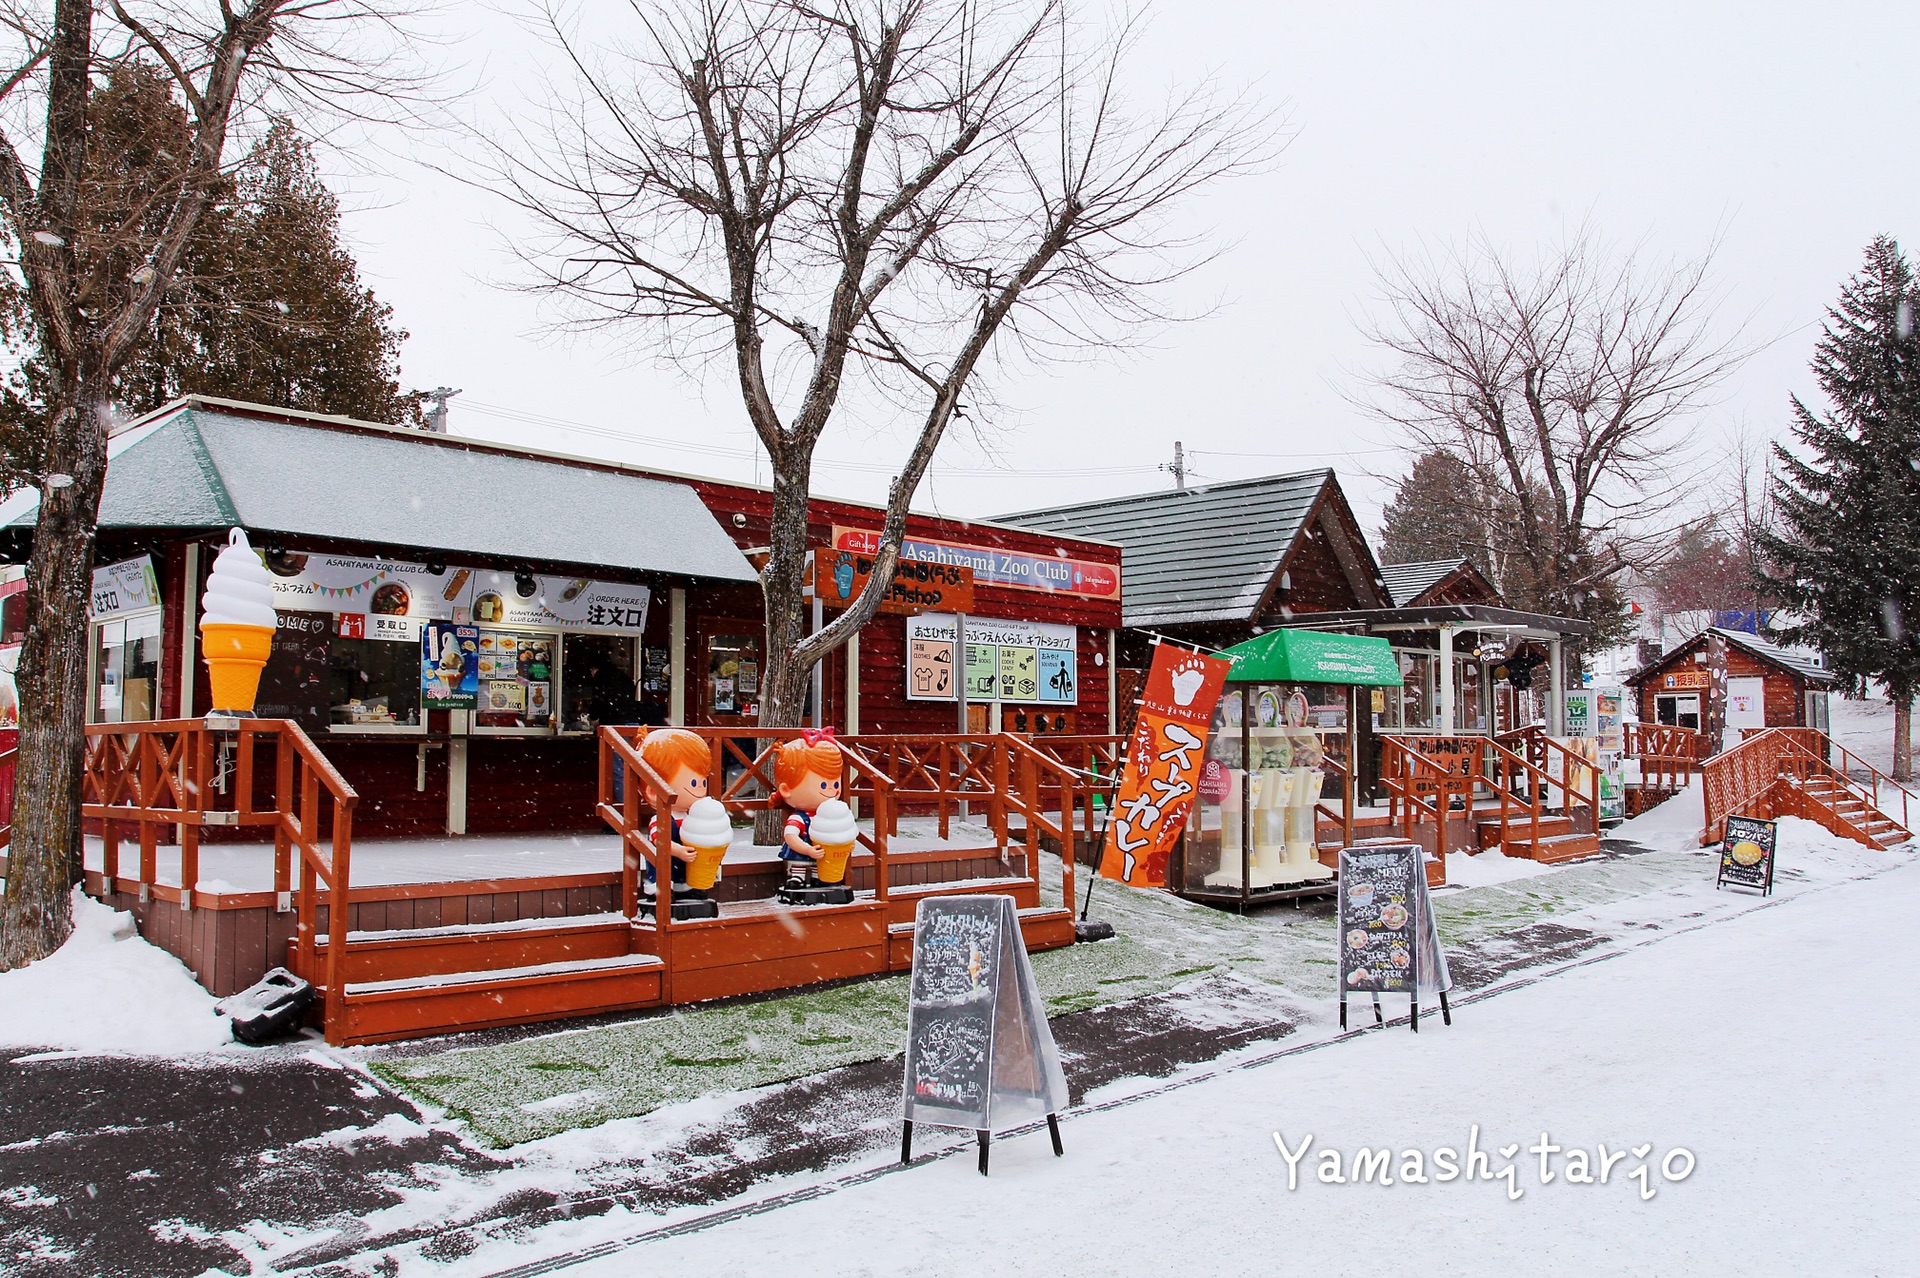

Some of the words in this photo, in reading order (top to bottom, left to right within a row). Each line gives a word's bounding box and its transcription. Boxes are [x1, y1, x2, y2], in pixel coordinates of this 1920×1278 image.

[849, 540, 861, 548] Gift
[862, 542, 876, 551] shop
[326, 558, 374, 570] ASAHIYAMA
[375, 562, 393, 572] ZOO
[394, 564, 416, 574] CLUB
[417, 565, 432, 575] CA
[904, 543, 996, 573] Asahiyama
[1000, 556, 1030, 576] Zoo
[1033, 561, 1069, 581] Club
[1085, 575, 1111, 585] Information
[271, 581, 314, 595] うぶつえん
[595, 595, 621, 604] ORDER
[621, 597, 640, 605] HERE
[509, 609, 543, 617] ASAHIYAMA
[587, 604, 643, 628] 注文口
[276, 615, 310, 632] OME
[376, 619, 408, 631] 受取口
[914, 625, 1023, 644] あさひやまうぶつえんくらぶ
[1026, 633, 1071, 648] ギフトショップ
[1001, 650, 1016, 658] お菓子
[1041, 653, 1059, 661] おみやげ
[1677, 674, 1708, 687] 授乳室
[1136, 721, 1152, 778] こだわり
[1114, 722, 1203, 883] スープカレー
[1730, 829, 1773, 843] メロンパン
